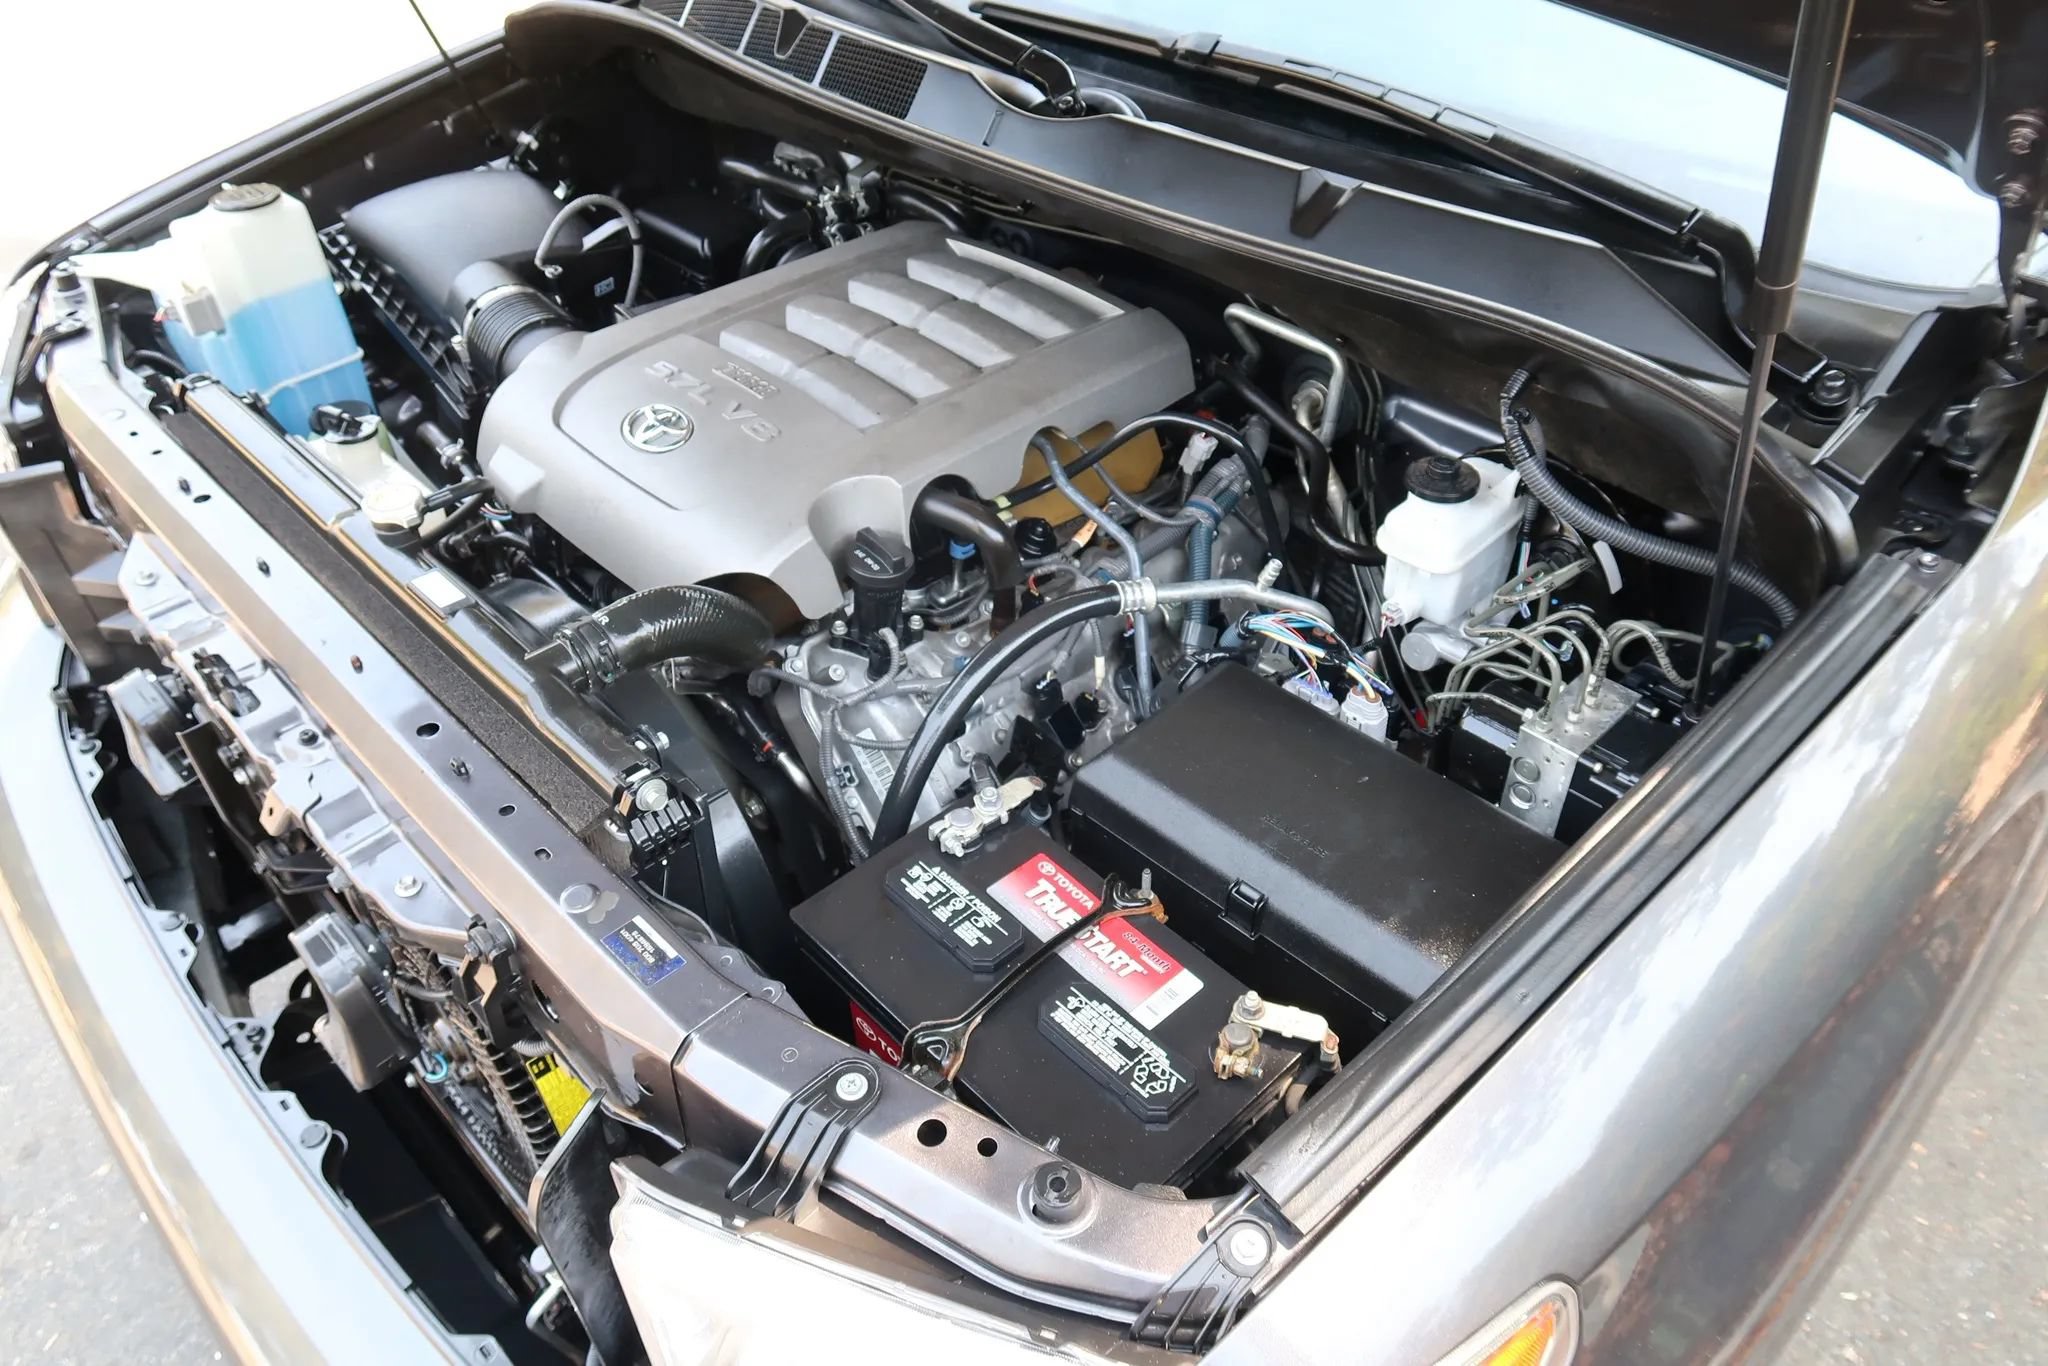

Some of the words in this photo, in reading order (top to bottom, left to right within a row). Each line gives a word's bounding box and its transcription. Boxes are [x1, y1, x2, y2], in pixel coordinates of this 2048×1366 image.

[938, 871, 970, 897] DANGER
[971, 898, 1002, 924] POISON
[1024, 878, 1083, 930] TRUE
[1053, 872, 1095, 910] TOYOTA
